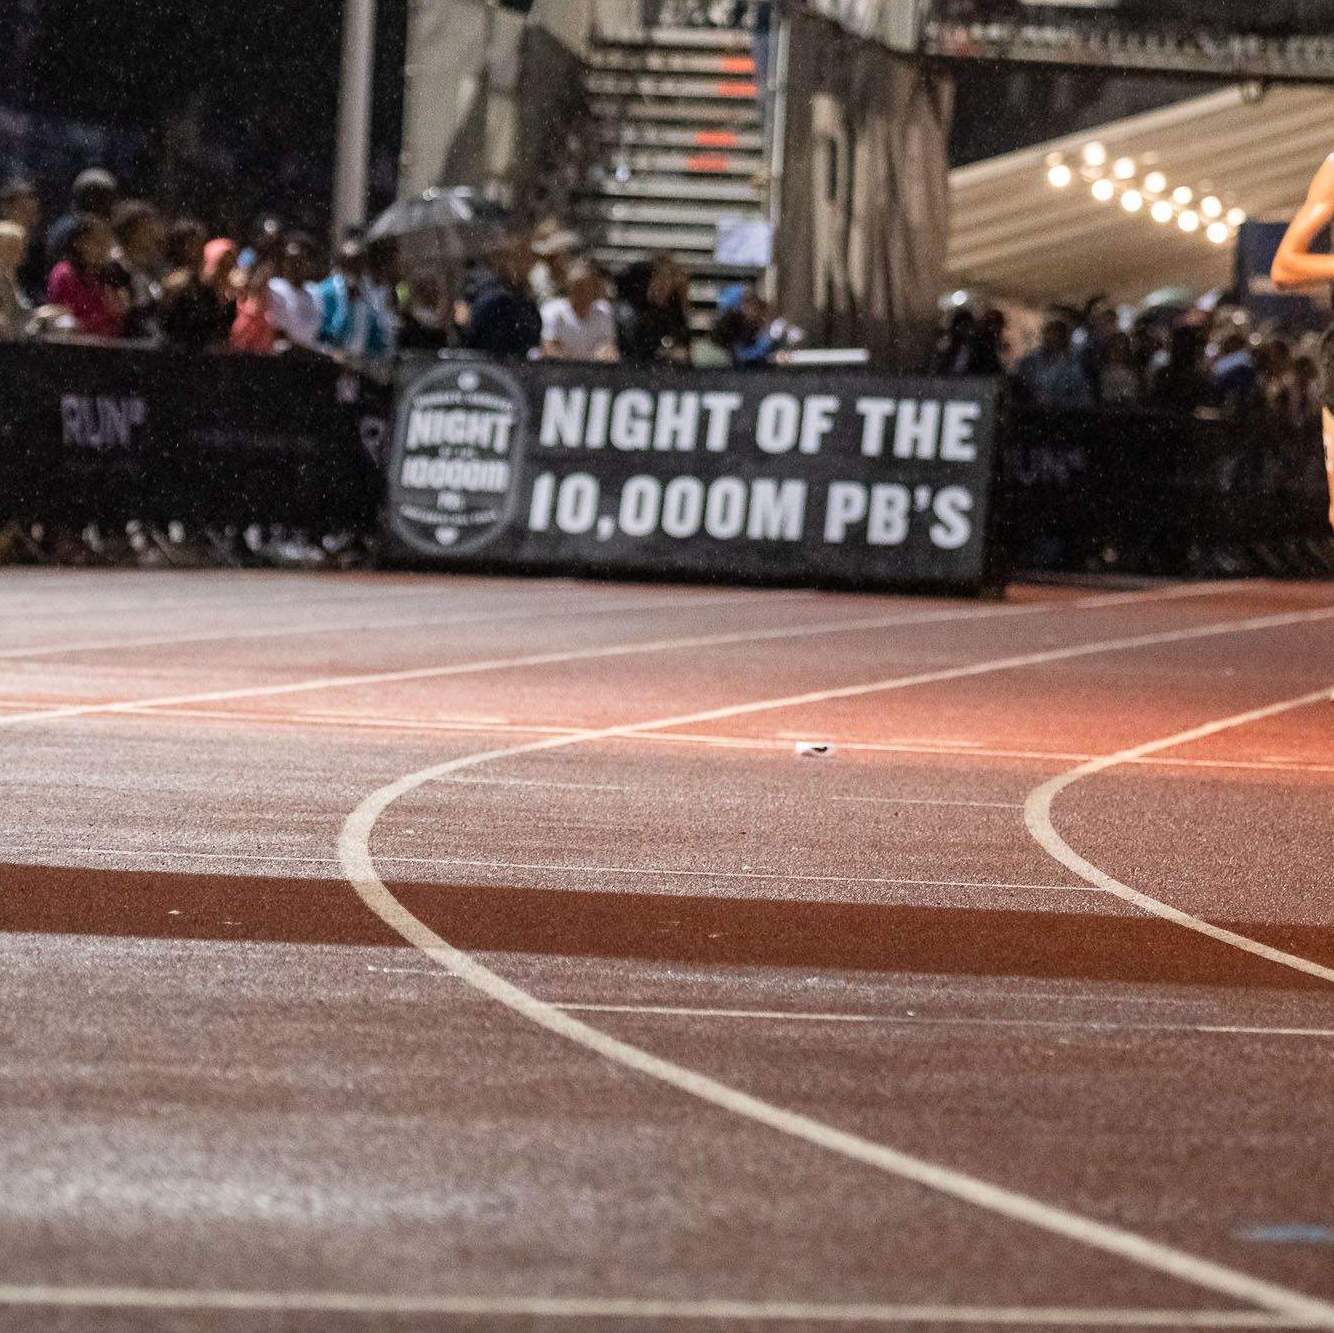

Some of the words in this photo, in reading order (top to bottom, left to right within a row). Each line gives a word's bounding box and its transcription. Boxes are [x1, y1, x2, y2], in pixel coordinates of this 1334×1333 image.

[405, 409, 512, 455] NIGHT
[539, 385, 743, 453] NIGHT
[754, 392, 841, 455] OF
[856, 396, 981, 462] THE
[528, 471, 809, 542] 10,000M
[823, 481, 973, 550] PB'S
